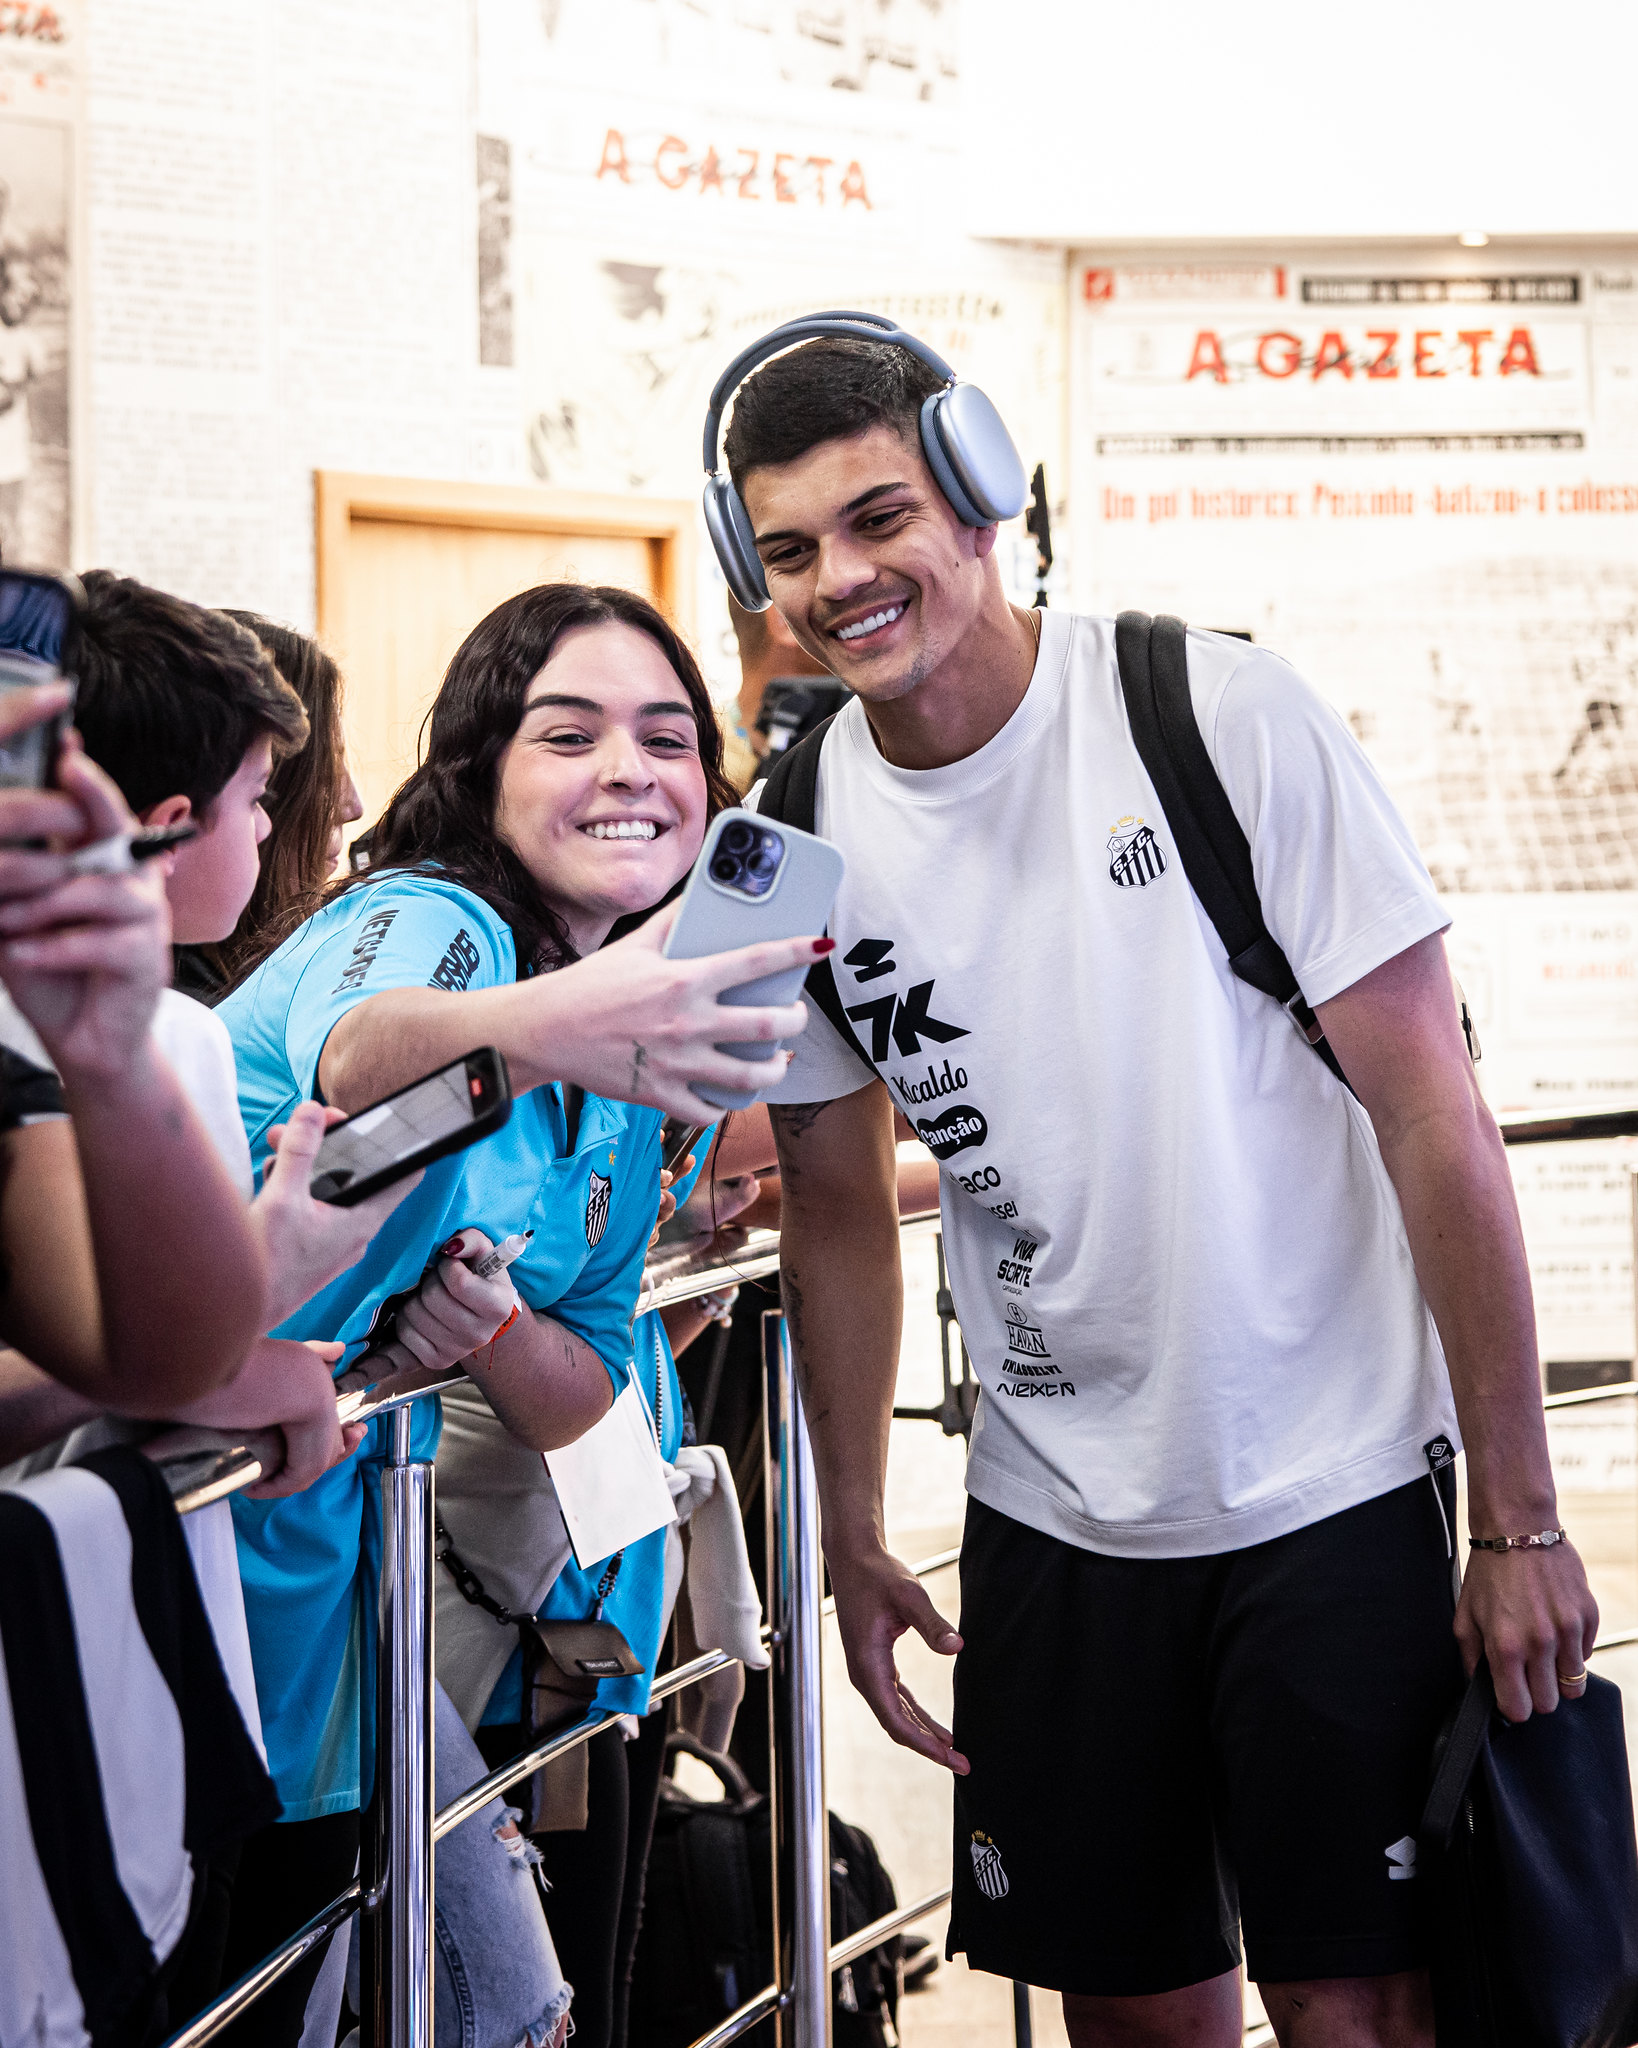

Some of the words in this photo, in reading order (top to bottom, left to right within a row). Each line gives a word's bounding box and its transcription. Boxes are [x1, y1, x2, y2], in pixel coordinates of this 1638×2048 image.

[596, 128, 630, 184] A
[653, 134, 873, 210] GAZETA
[1186, 331, 1229, 383] A
[1257, 329, 1540, 382] GAZETA
[331, 909, 400, 995] NETSHOES
[844, 978, 972, 1063] 7K
[890, 1058, 968, 1105] Kicaldo
[919, 1116, 983, 1147] Canção
[1012, 1238, 1038, 1262] VIVA
[997, 1259, 1033, 1288] SORTE
[1006, 1325, 1046, 1353] HAVAN
[1002, 1358, 1063, 1377] UNIASSELVI
